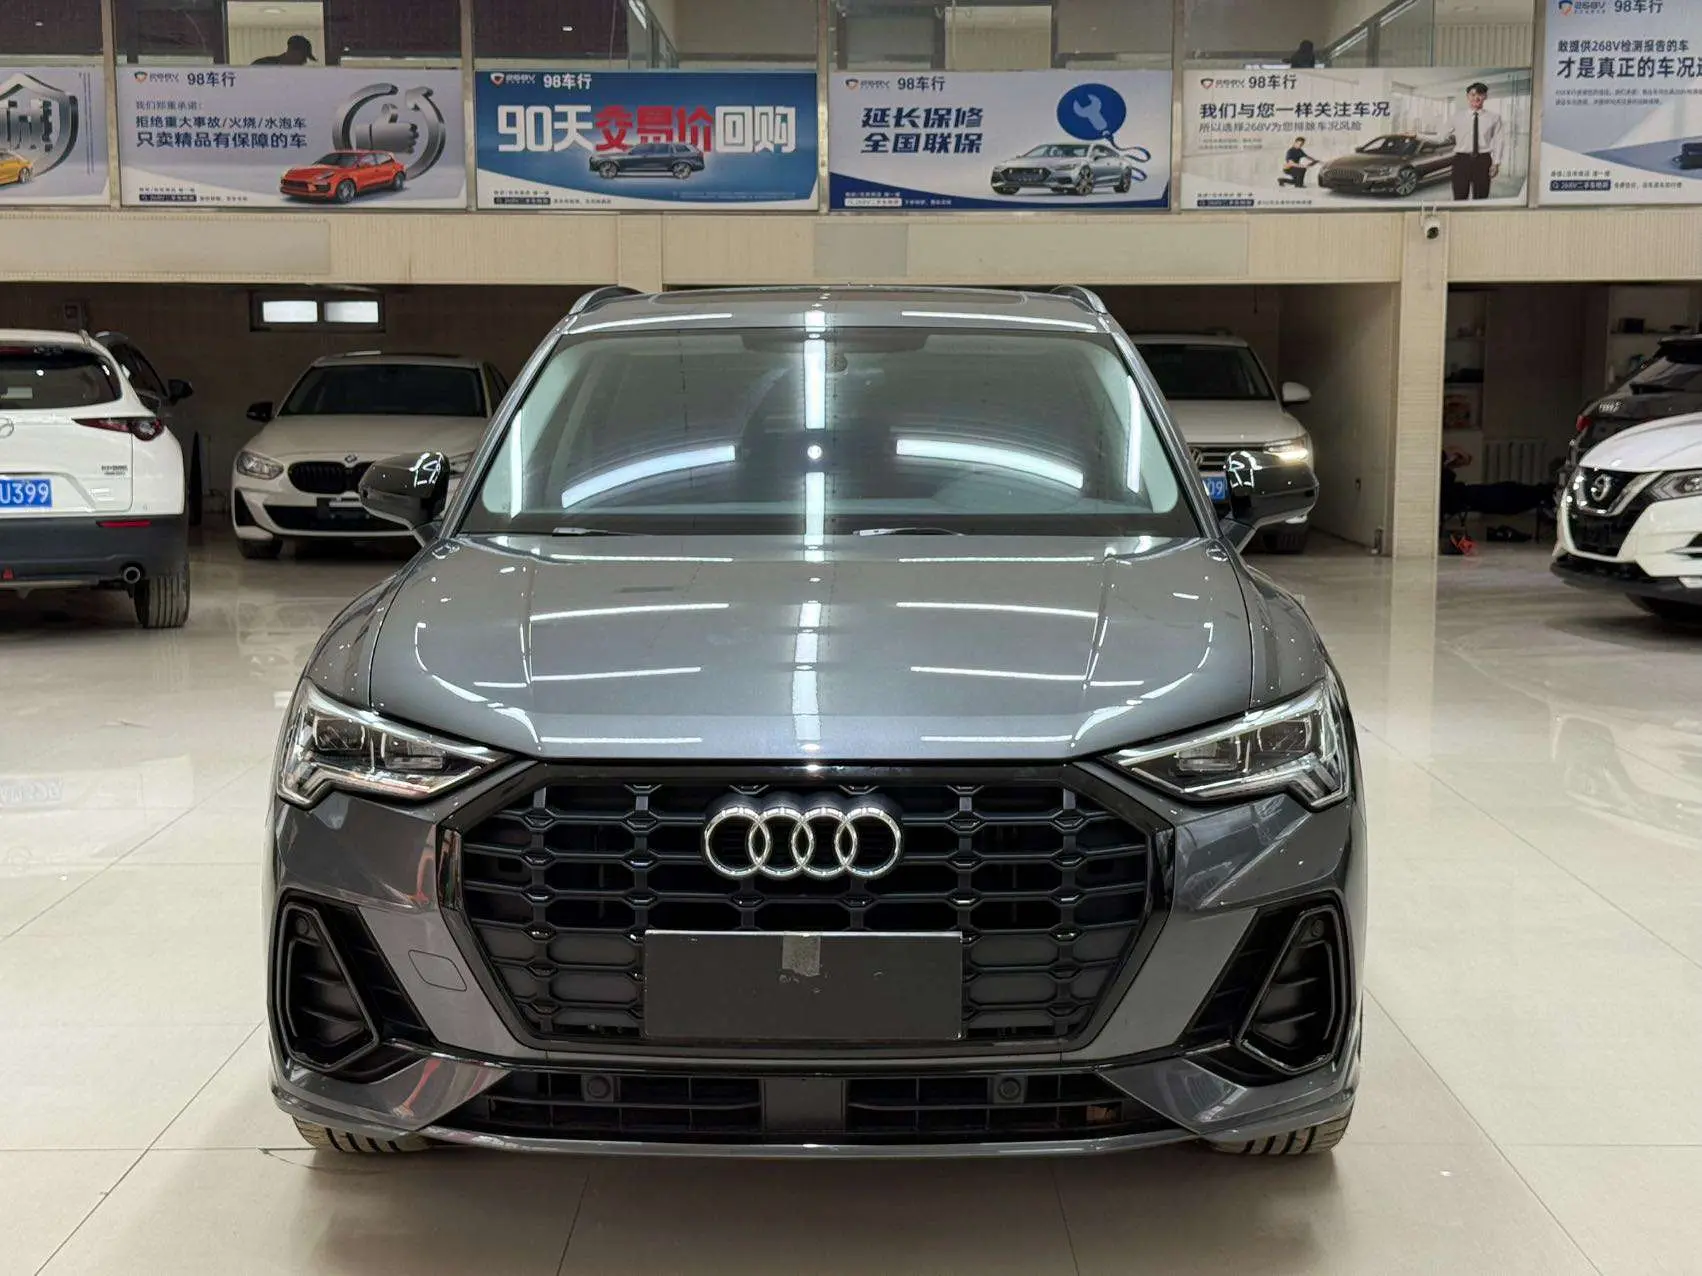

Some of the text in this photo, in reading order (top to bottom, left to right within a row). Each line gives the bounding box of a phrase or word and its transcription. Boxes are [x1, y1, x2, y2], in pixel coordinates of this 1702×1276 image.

[1614, 0, 1663, 13] 98车行
[187, 71, 236, 87] 98车行
[543, 73, 592, 90] 98车行
[897, 76, 945, 92] 98车行
[1248, 74, 1297, 90] 98车行
[861, 107, 984, 129] 延长保修
[1199, 101, 1391, 119] 我们与您一样关注车况
[497, 104, 796, 154] 90天交易价回购
[136, 132, 308, 149] 只卖精品有保障的车
[861, 133, 984, 154] 全国联保
[0, 483, 49, 504] U399
